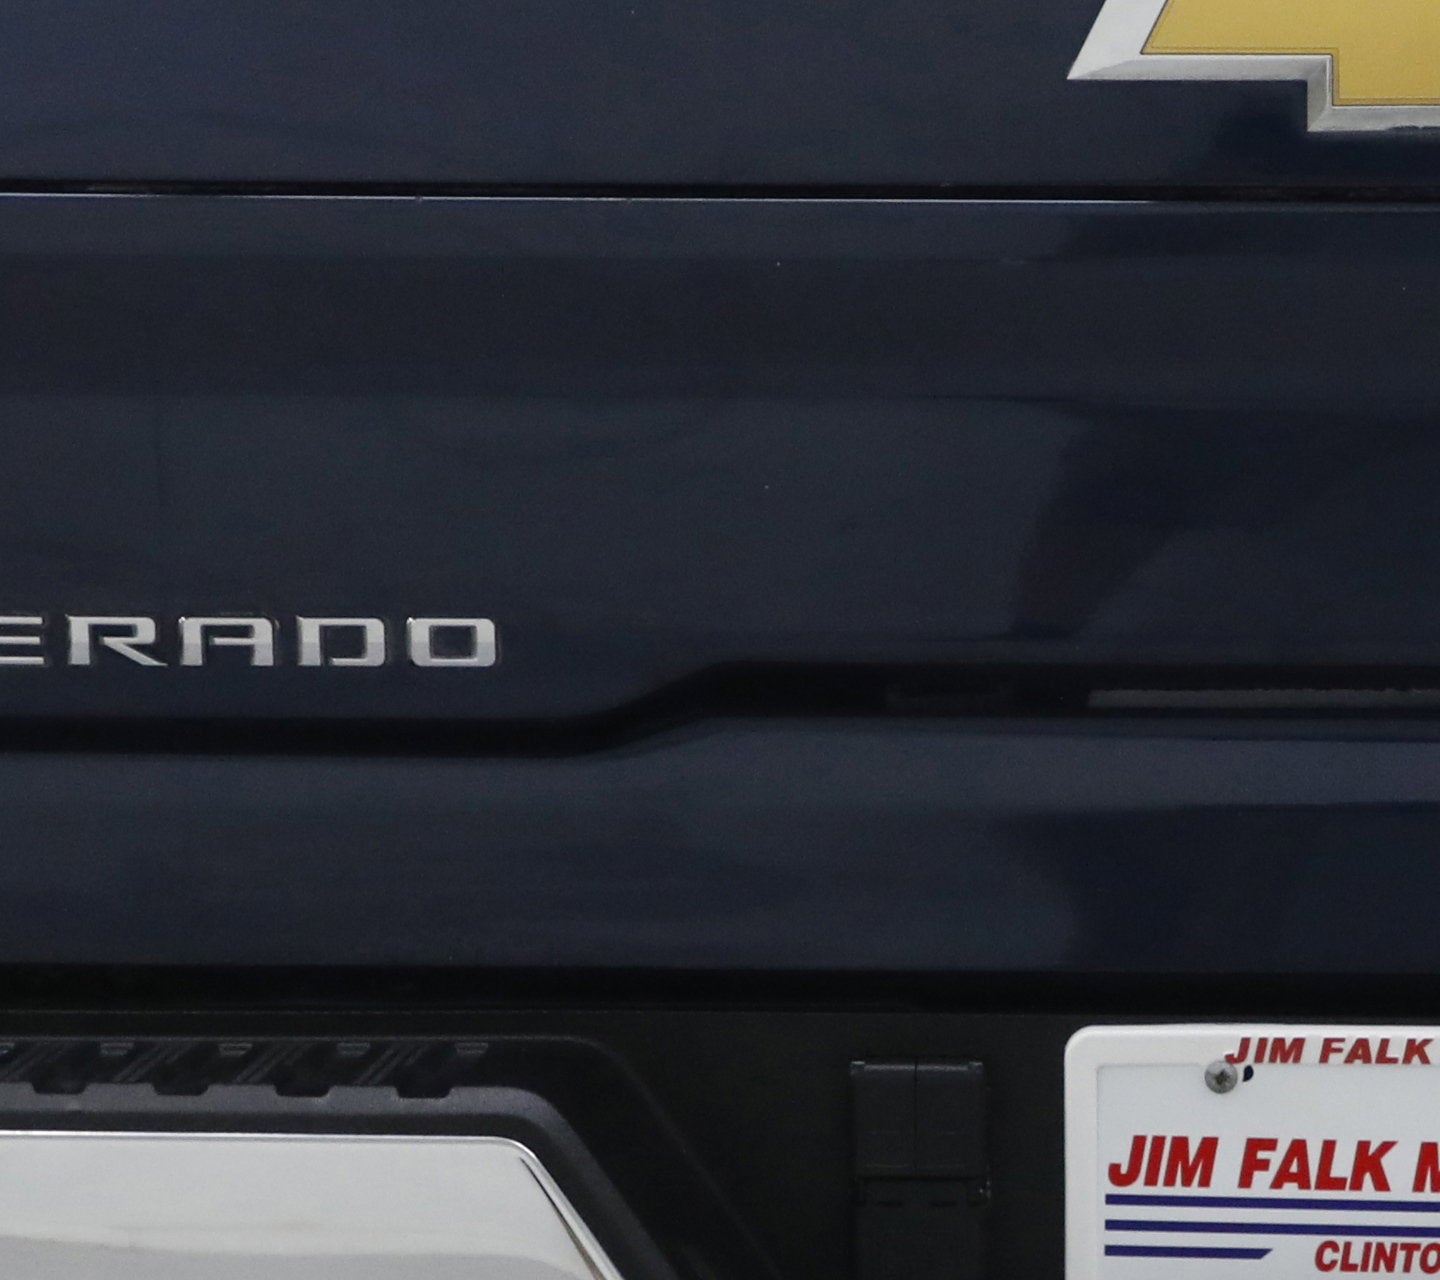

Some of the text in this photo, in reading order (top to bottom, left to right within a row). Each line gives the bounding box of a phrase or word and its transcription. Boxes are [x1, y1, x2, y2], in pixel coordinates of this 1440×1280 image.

[1225, 1037, 1304, 1065] JIM
[1319, 1037, 1434, 1066] FALK
[1107, 1135, 1219, 1188] JIM
[1237, 1137, 1399, 1193] FALK
